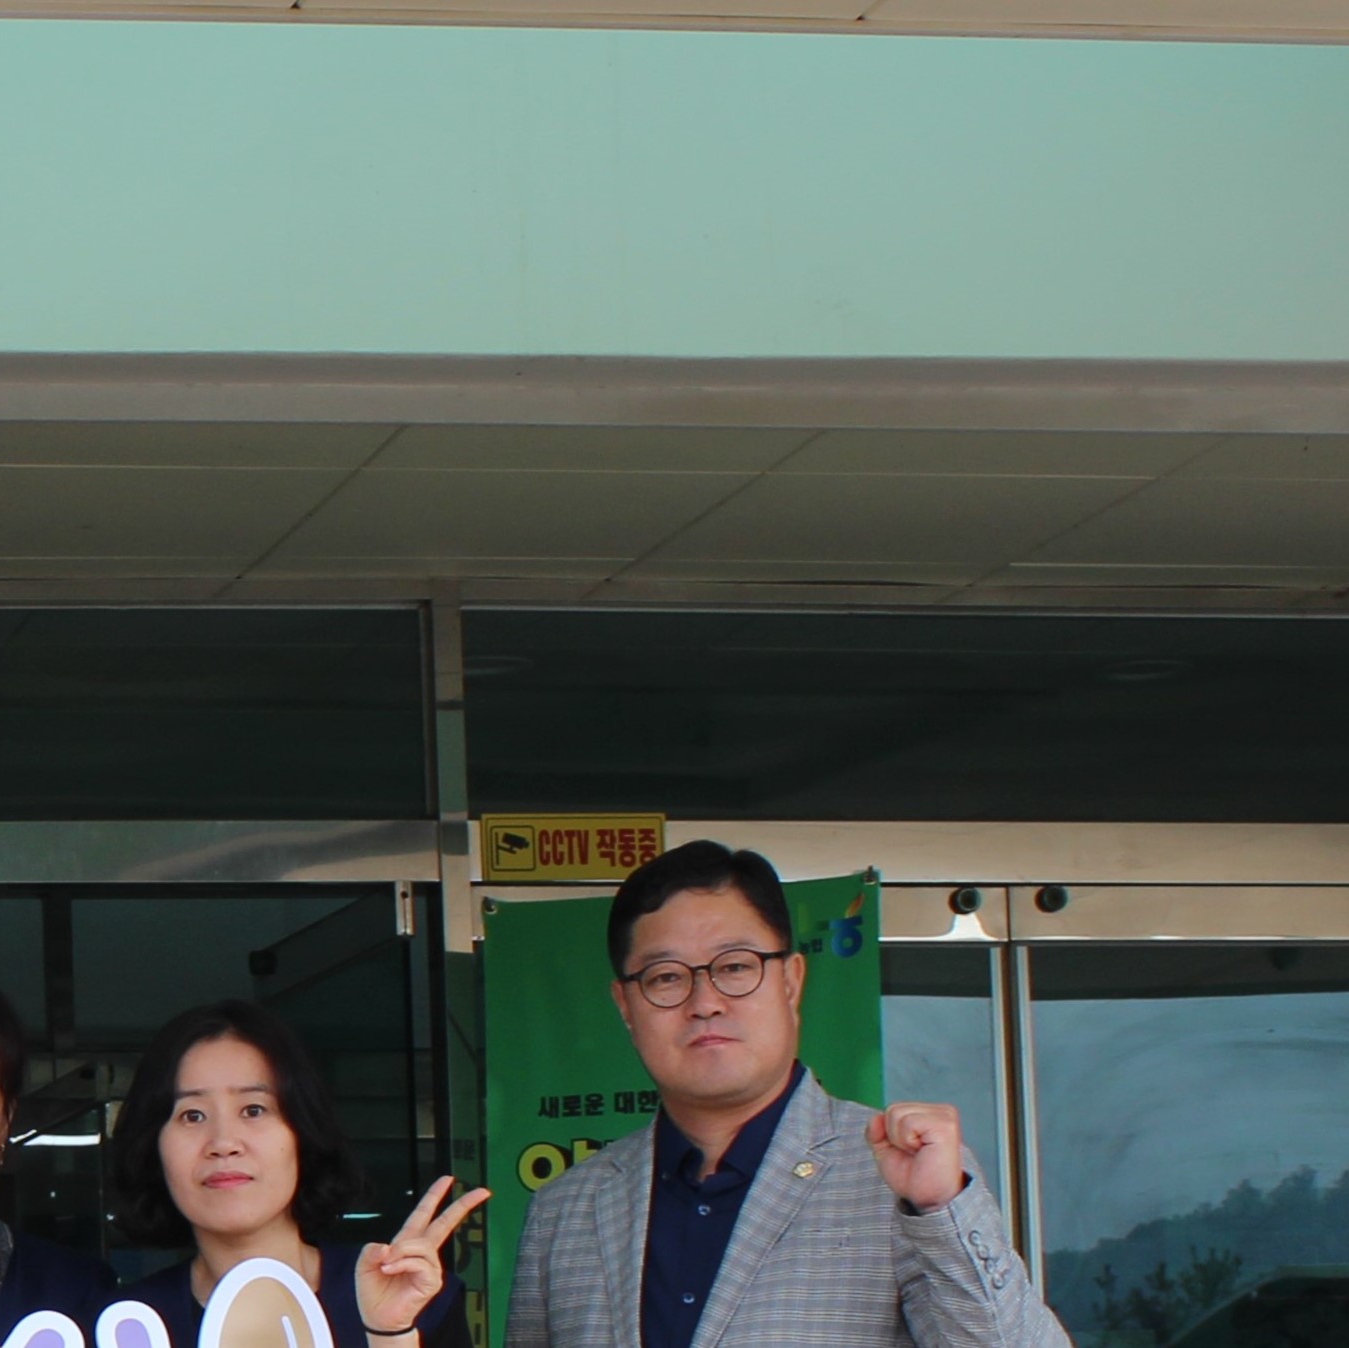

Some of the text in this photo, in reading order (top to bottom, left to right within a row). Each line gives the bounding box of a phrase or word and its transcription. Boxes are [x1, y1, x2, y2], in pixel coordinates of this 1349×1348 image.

[539, 828, 656, 867] CCTV 작동중
[538, 1093, 604, 1118] 새로운
